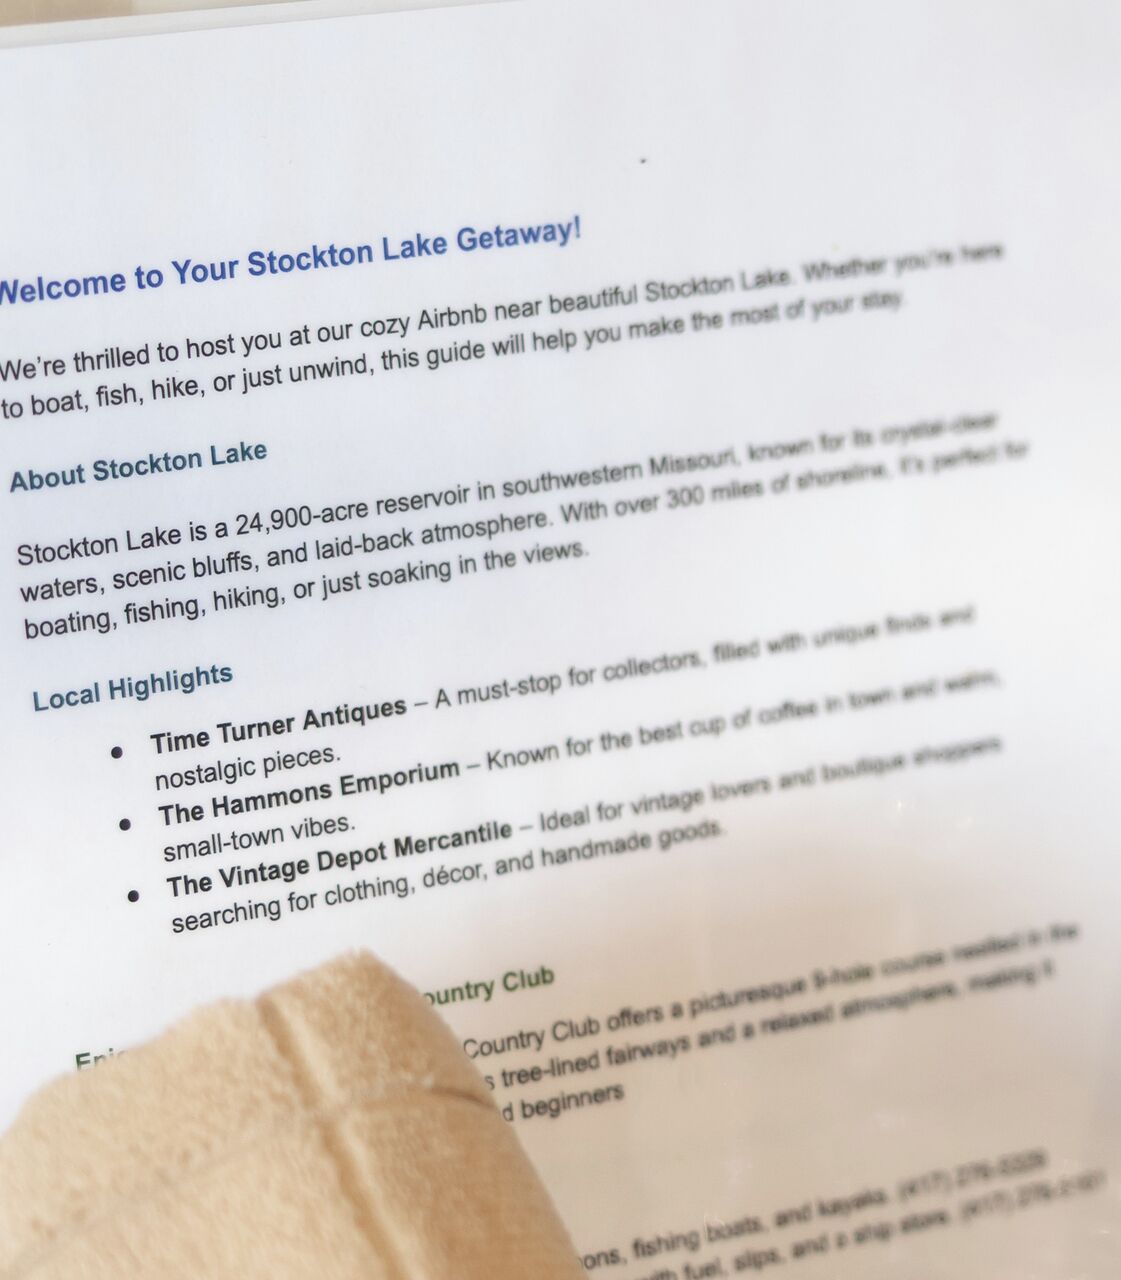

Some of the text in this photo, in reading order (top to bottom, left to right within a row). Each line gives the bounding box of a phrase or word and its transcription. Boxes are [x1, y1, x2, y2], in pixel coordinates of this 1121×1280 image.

[135, 266, 163, 289] to
[171, 259, 239, 284] Your
[248, 244, 373, 276] Stockton
[383, 233, 447, 260] Lake
[457, 215, 580, 251] Getaway!
[0, 356, 65, 381] We’re
[73, 344, 149, 372] thrilled
[157, 342, 179, 362] to
[186, 334, 235, 359] host
[241, 333, 281, 357] you
[290, 325, 311, 346] at
[318, 324, 353, 342] our
[361, 317, 410, 338] cozy
[418, 304, 487, 330] Airbnb
[495, 301, 542, 320] near
[549, 285, 638, 314] beautiful
[645, 277, 734, 302] Stockton
[1, 399, 23, 419] to
[31, 390, 88, 415] boat,
[96, 383, 143, 407] fish,
[152, 377, 204, 400] hike,
[214, 374, 235, 392] or
[242, 365, 282, 394] just
[289, 353, 374, 382] unwind,
[381, 350, 419, 370] this
[427, 340, 485, 370] guide
[492, 333, 525, 356] will
[533, 329, 577, 352] help
[584, 327, 621, 350] you
[628, 316, 685, 339] make
[691, 312, 723, 331] the
[730, 303, 780, 325] most
[785, 298, 805, 320] of
[810, 296, 854, 321] your
[10, 442, 267, 493] About Stockton Lake
[18, 537, 118, 566] Stockton
[126, 526, 181, 550] Lake
[190, 522, 207, 541] is
[215, 522, 228, 538] a
[236, 503, 368, 535] 24,900-acre
[376, 484, 470, 515] reservoir
[478, 481, 495, 501] in
[502, 464, 643, 497] southwestern
[818, 433, 845, 452] for
[20, 473, 790, 602] waters, scenic bluffs, and laid-back atmosphere. With over 300 miles of
[25, 542, 587, 639] boating, fishing, hiking, or just soaking in the views.
[33, 665, 233, 711] Local Highlights
[150, 732, 209, 754] Time
[217, 717, 295, 743] Turner
[303, 700, 407, 730] Antiques
[435, 688, 451, 709] A
[458, 674, 561, 704] must-stop
[568, 667, 596, 686] for
[602, 652, 706, 682] collectors,
[712, 640, 760, 662] filled
[766, 632, 807, 654] with
[156, 748, 340, 790] nostalgic pieces.
[158, 804, 204, 825] The
[212, 784, 332, 817] Hammons
[340, 762, 460, 795] Emporium
[487, 745, 559, 770] Known
[565, 737, 593, 757] for
[599, 732, 632, 752] the
[638, 721, 683, 745] best
[689, 717, 726, 737] cup
[731, 708, 751, 730] of
[757, 700, 819, 725] coffee
[900, 679, 939, 701] and
[164, 817, 354, 862] small-town vibes.
[166, 875, 212, 897] The
[219, 860, 309, 887] Vintage
[317, 842, 387, 871] Depot
[394, 821, 512, 857] Mercantile
[540, 806, 590, 832] Ideal
[596, 802, 624, 821] for
[630, 790, 704, 815] vintage
[711, 778, 772, 801] lovers
[778, 768, 816, 790] and
[172, 900, 281, 933] searching
[288, 892, 317, 912] for
[325, 877, 415, 905] clothing,
[423, 864, 487, 888] décor,
[495, 850, 534, 875] and
[541, 833, 652, 866] handmade
[424, 966, 554, 1005] ountry Club
[464, 1030, 545, 1059] Country
[551, 1017, 600, 1042] Club
[606, 1006, 664, 1032] offers
[670, 1002, 684, 1019] a
[501, 1051, 600, 1088] tree-lined
[605, 1036, 691, 1066] fairways
[697, 1025, 736, 1048] and
[520, 1084, 624, 1119] beginners
[632, 1231, 700, 1259] fishing
